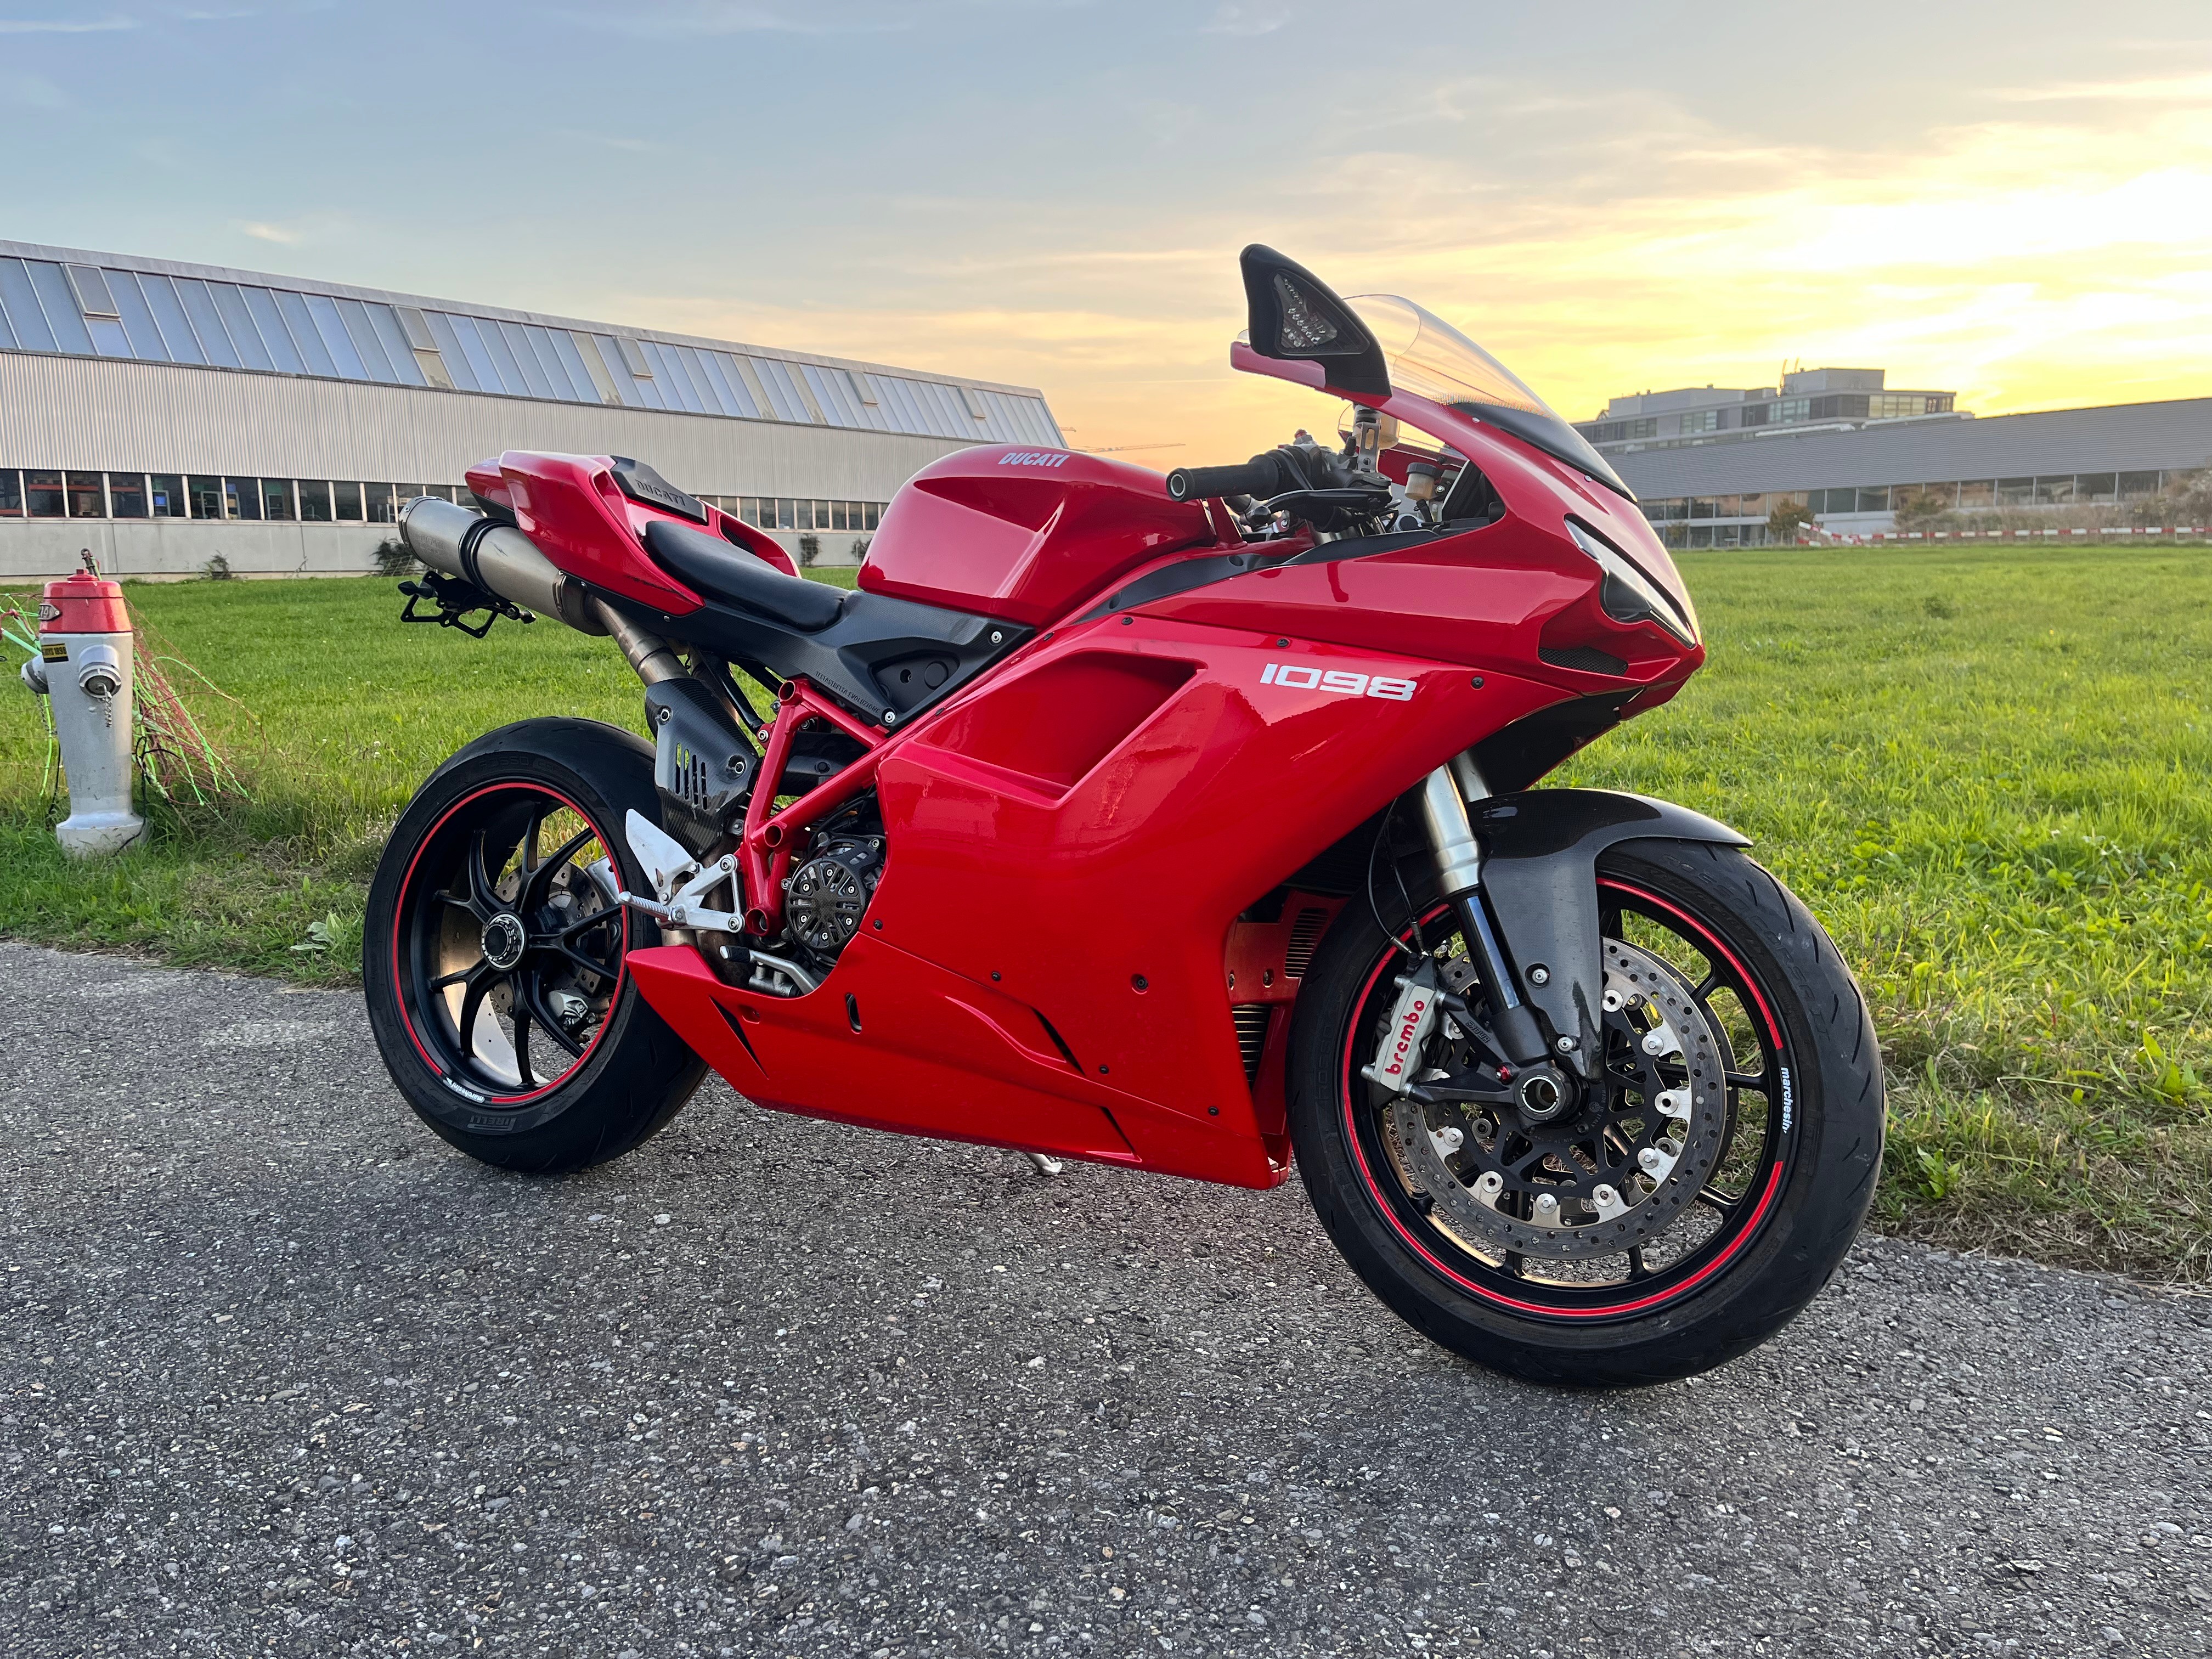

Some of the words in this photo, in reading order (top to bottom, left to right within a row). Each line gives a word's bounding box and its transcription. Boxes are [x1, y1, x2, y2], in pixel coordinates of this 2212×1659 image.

[997, 452, 1070, 467] DUCATI
[634, 478, 686, 506] DUCATI
[1259, 663, 1418, 701] 1098
[1385, 1000, 1425, 1075] brembo
[1465, 1020, 1491, 1043] SHOWA
[467, 1115, 517, 1131] PIRELLI
